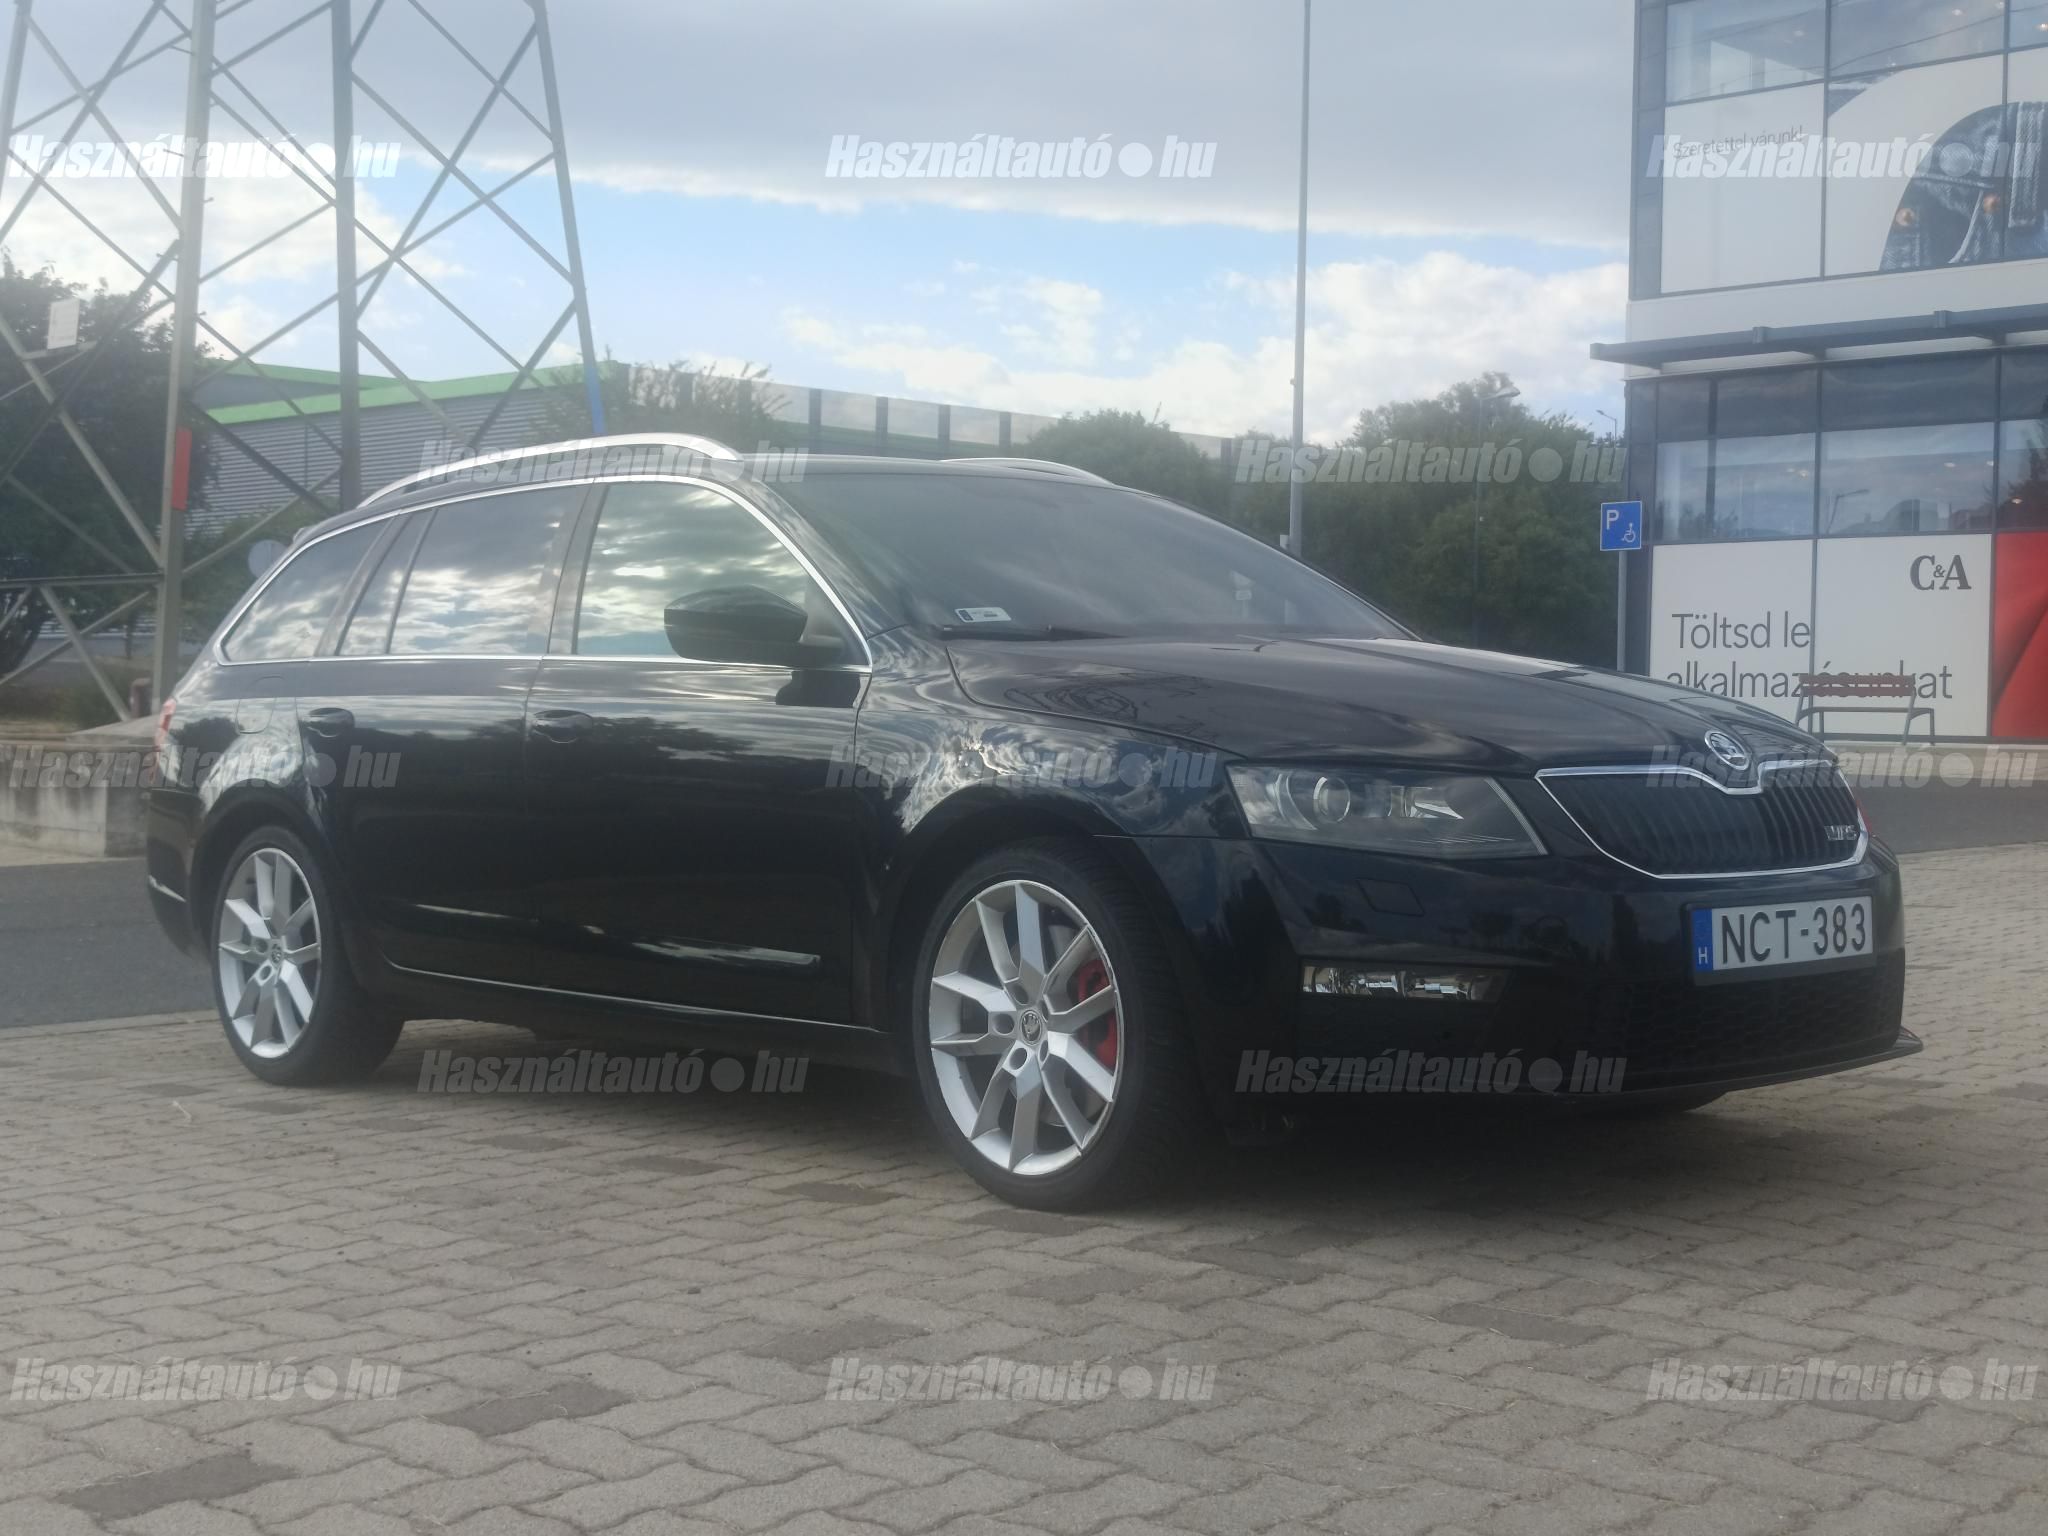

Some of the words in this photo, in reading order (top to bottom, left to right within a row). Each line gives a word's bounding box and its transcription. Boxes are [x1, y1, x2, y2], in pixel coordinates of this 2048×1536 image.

[1673, 133, 1746, 157] Szeretettel
[1606, 509, 1619, 530] P
[1910, 554, 1972, 590] C&A
[1672, 611, 1771, 649] Töltsd
[1784, 611, 1810, 648] le
[1721, 903, 1866, 964] NCT-383
[1698, 946, 1708, 964] H
